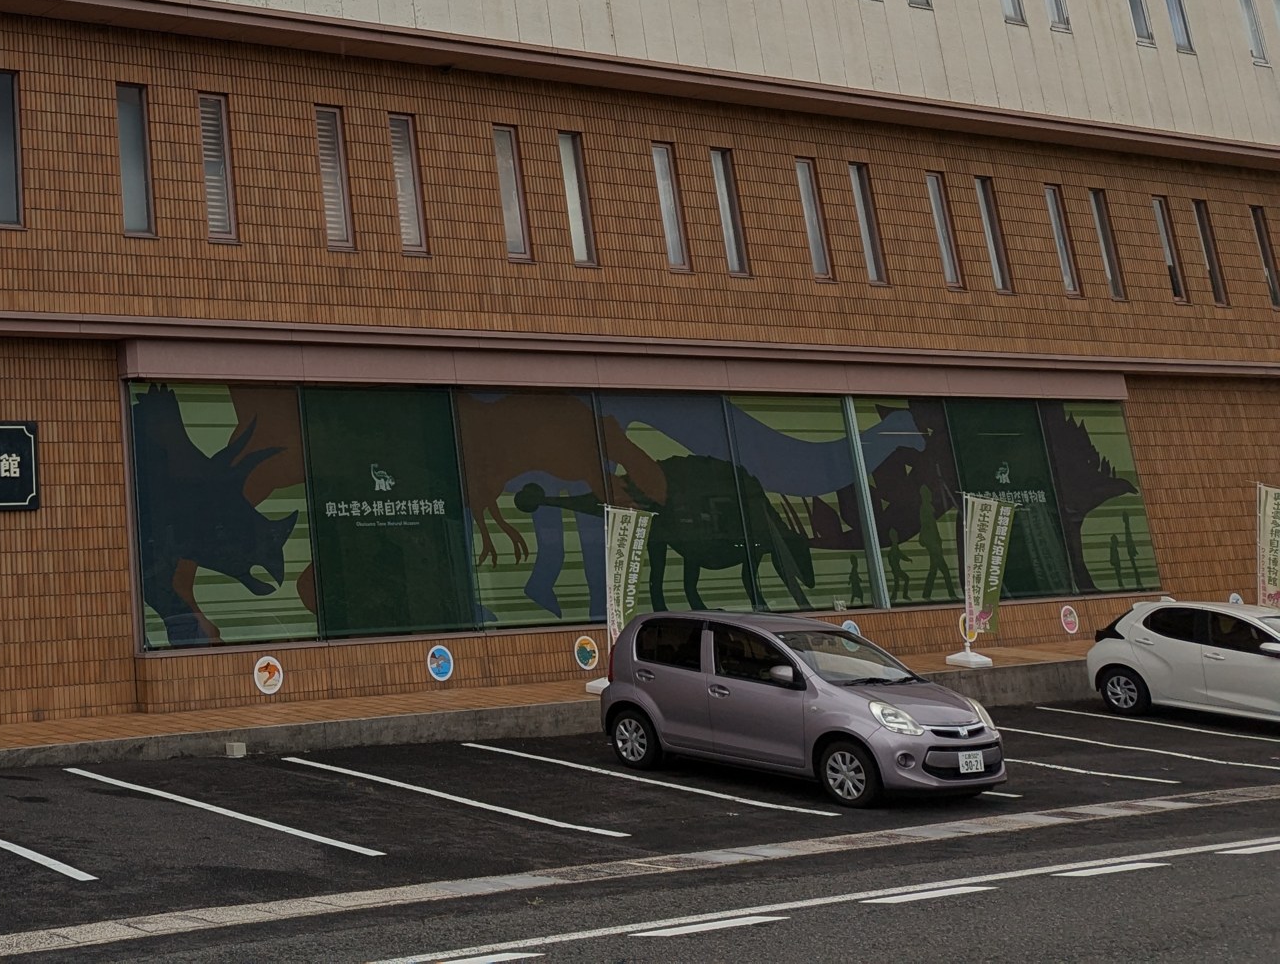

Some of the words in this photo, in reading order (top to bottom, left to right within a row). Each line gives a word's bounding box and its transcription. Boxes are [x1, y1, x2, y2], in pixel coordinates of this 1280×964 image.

[325, 499, 446, 518] 奥出雲多根自然博物館
